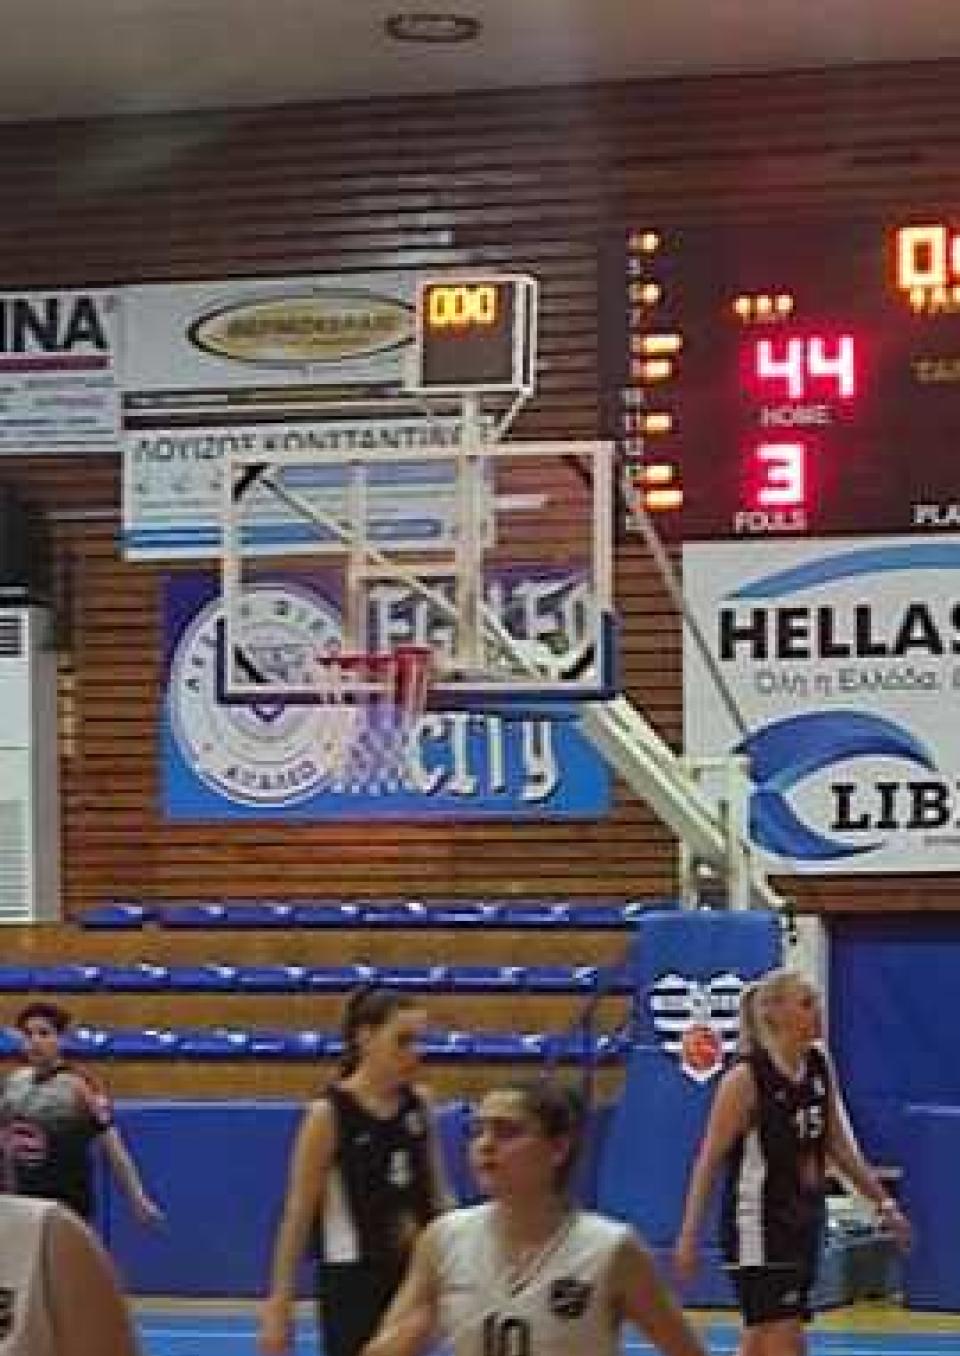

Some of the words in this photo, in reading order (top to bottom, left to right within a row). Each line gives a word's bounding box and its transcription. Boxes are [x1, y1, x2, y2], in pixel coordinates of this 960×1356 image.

[756, 337, 854, 399] 44
[757, 443, 806, 505] 3
[735, 510, 807, 532] FOULS
